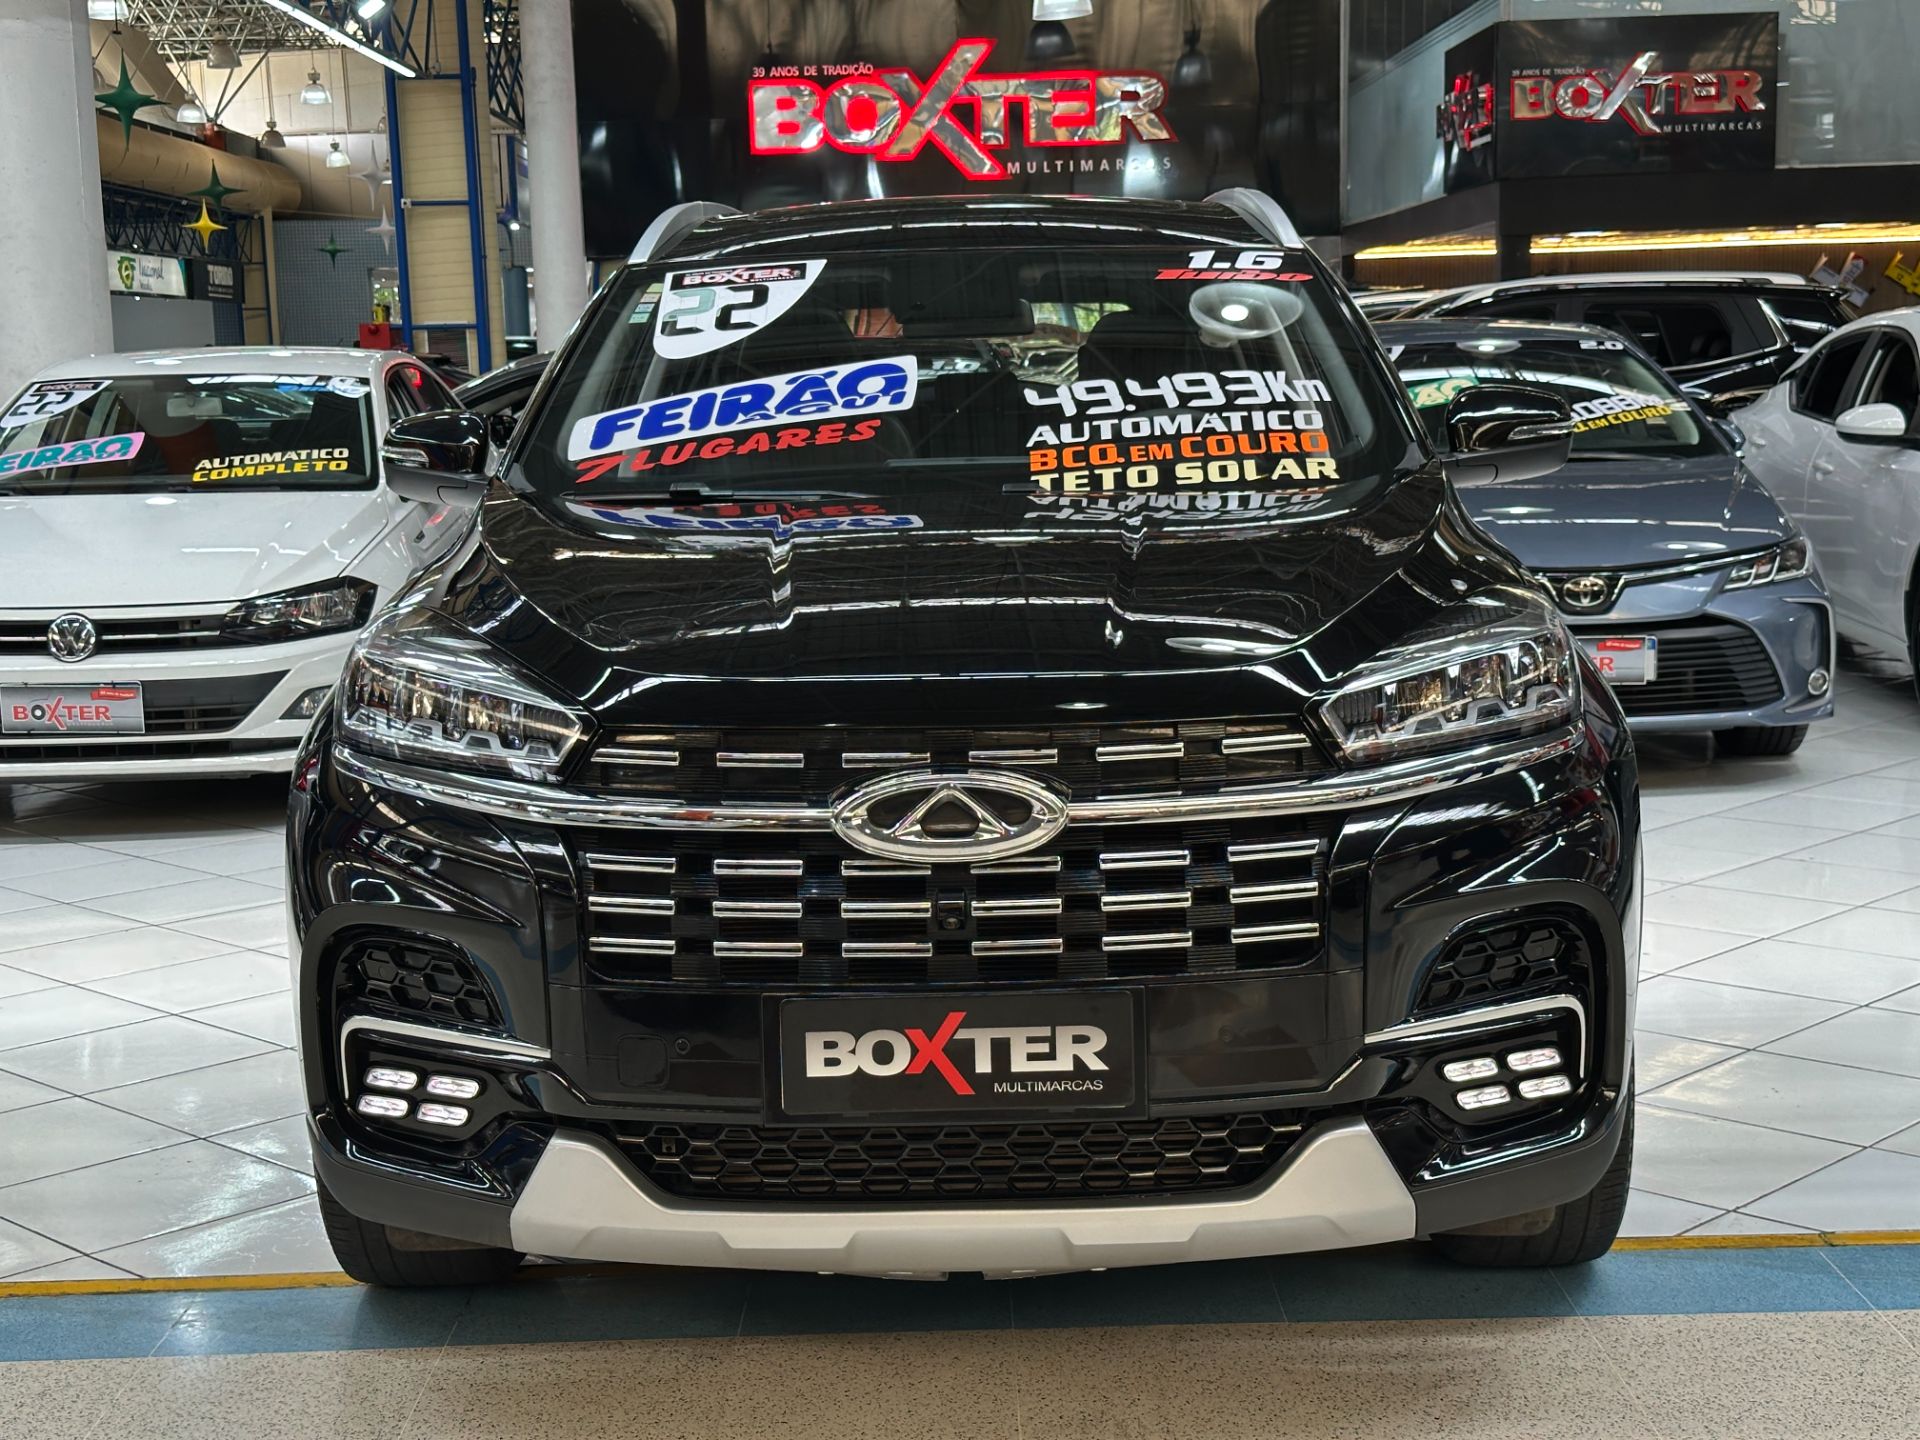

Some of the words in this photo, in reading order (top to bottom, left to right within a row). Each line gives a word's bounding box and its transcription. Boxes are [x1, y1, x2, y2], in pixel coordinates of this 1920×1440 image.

[753, 67, 766, 78] 39
[770, 66, 800, 77] ANOS
[804, 65, 818, 76] DE
[822, 62, 874, 76] TRADIÇÃO
[1510, 51, 1766, 135] BOXTER
[748, 38, 1179, 180] BOXTER
[1663, 121, 1762, 134] MULTIMARCAS
[1188, 250, 1285, 270] 1.6
[682, 267, 790, 286] BOXTER
[660, 283, 770, 337] 22
[1578, 340, 1624, 350] 2.0
[8, 391, 75, 417] 22
[589, 363, 908, 451] FEIRÃO
[1607, 405, 1673, 425] COURO
[195, 448, 350, 471] AUTOMATICO
[575, 454, 631, 483] 7
[630, 419, 881, 472] LUGARES
[1130, 442, 1174, 462] EM
[1180, 431, 1330, 458] COURO
[192, 460, 349, 482] COMPLETO
[1030, 465, 1159, 492] TETO
[1175, 457, 1340, 486] SOLAR
[12, 696, 112, 730] BOXTER
[805, 1011, 1110, 1095] BOXTER
[994, 1079, 1104, 1093] MULTIMARCAS
